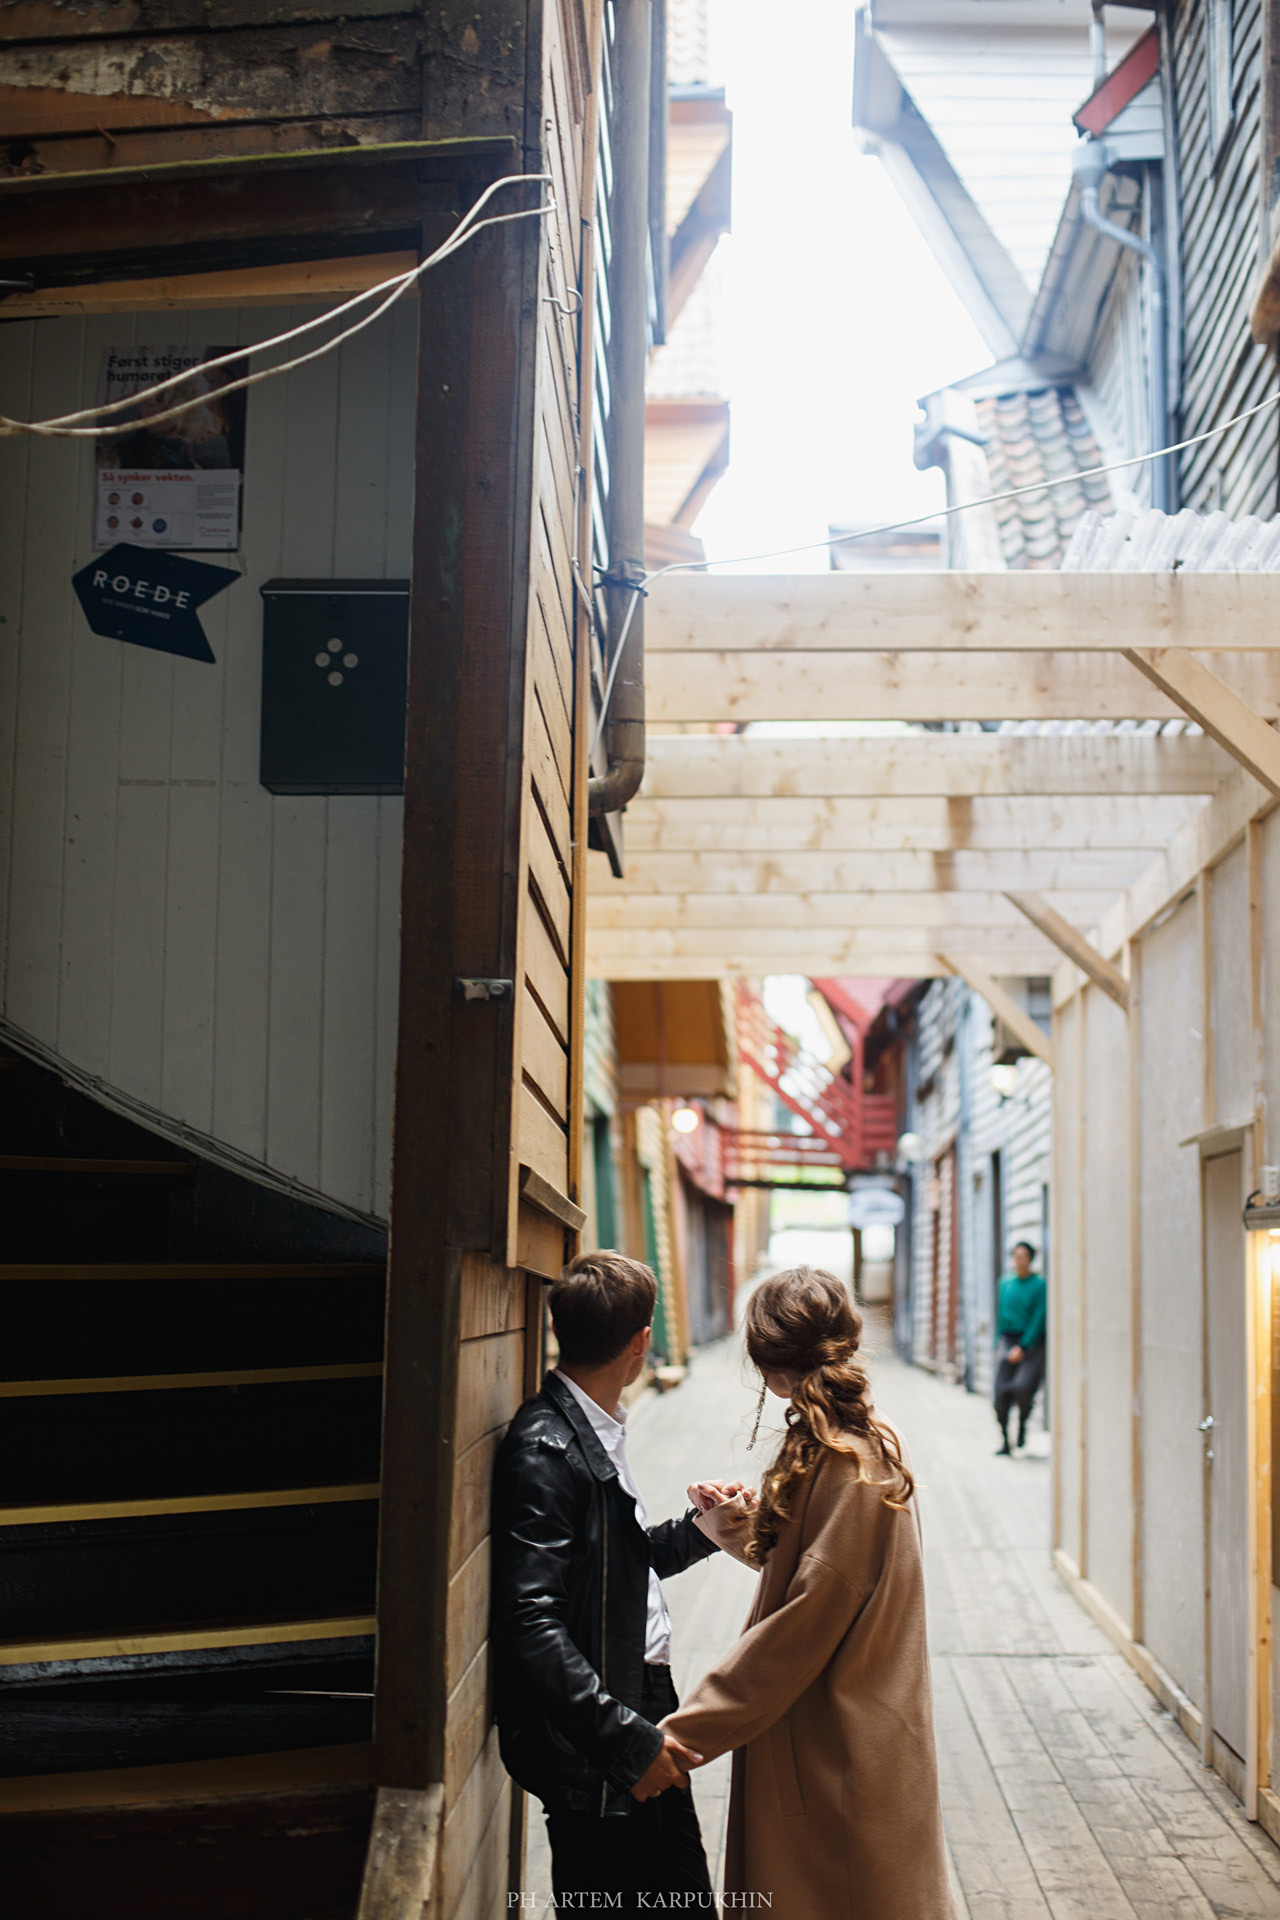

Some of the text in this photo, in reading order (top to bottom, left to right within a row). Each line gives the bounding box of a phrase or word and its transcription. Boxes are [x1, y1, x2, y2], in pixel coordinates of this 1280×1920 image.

[153, 354, 199, 370] stiger
[102, 472, 114, 482] Så
[118, 472, 152, 484] synker
[92, 568, 191, 610] ROEDE
